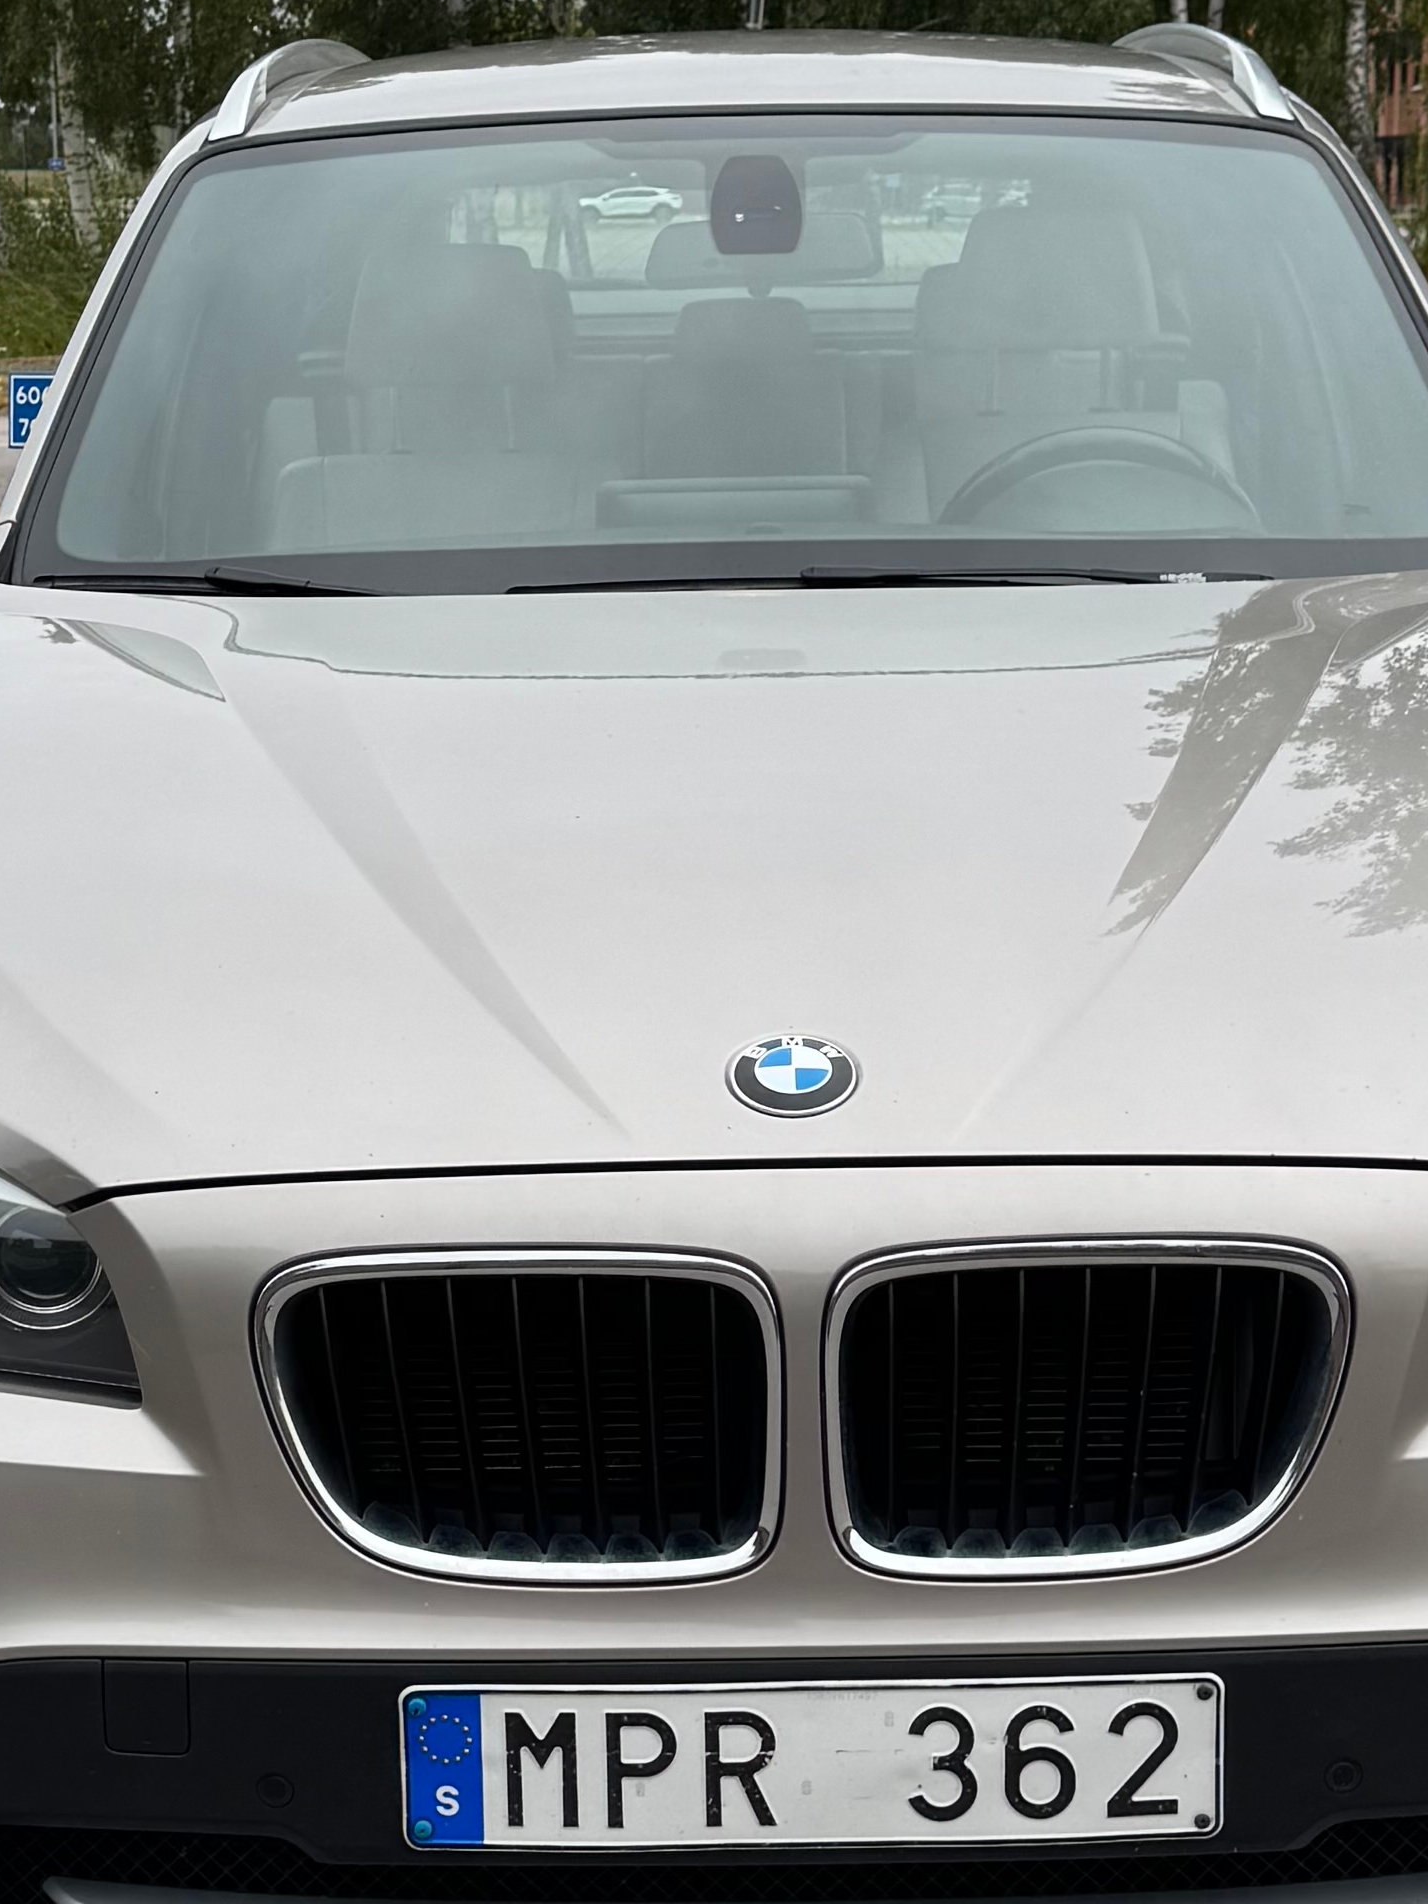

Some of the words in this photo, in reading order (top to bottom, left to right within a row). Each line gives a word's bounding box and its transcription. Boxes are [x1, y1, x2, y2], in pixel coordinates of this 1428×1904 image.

[744, 1036, 844, 1060] BMW
[503, 1710, 778, 1829] MPR
[907, 1701, 1179, 1822] 362
[435, 1784, 461, 1816] S
